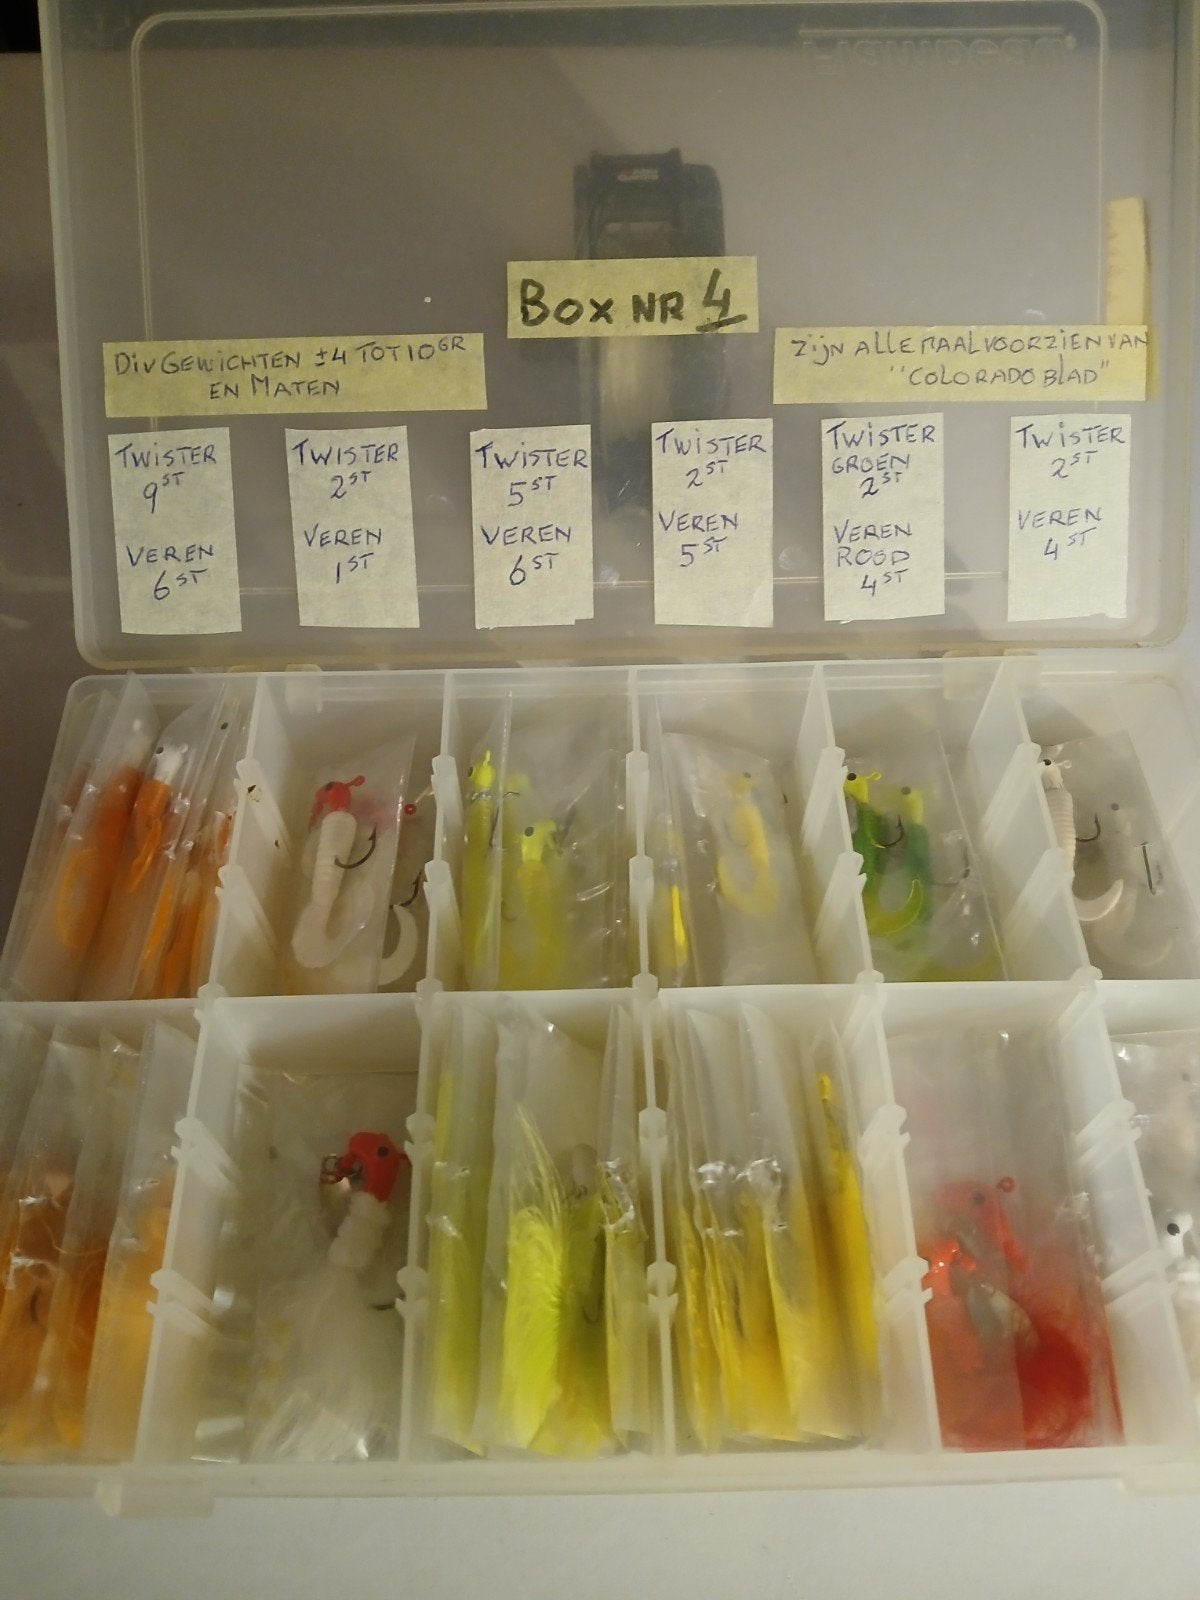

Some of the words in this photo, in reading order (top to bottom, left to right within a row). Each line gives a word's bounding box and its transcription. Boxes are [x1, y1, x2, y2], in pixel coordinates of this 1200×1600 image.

[631, 291, 685, 325] NR
[699, 268, 738, 326] 4
[209, 381, 240, 400] EN
[292, 438, 399, 466] TWISTER
[832, 453, 910, 474] GROEN
[658, 510, 738, 533] VEREN
[1018, 507, 1102, 530] VEREN
[304, 523, 382, 548] VEREN
[480, 523, 571, 546] VEREN
[834, 519, 912, 544] VEREN
[126, 544, 214, 567] VEREN
